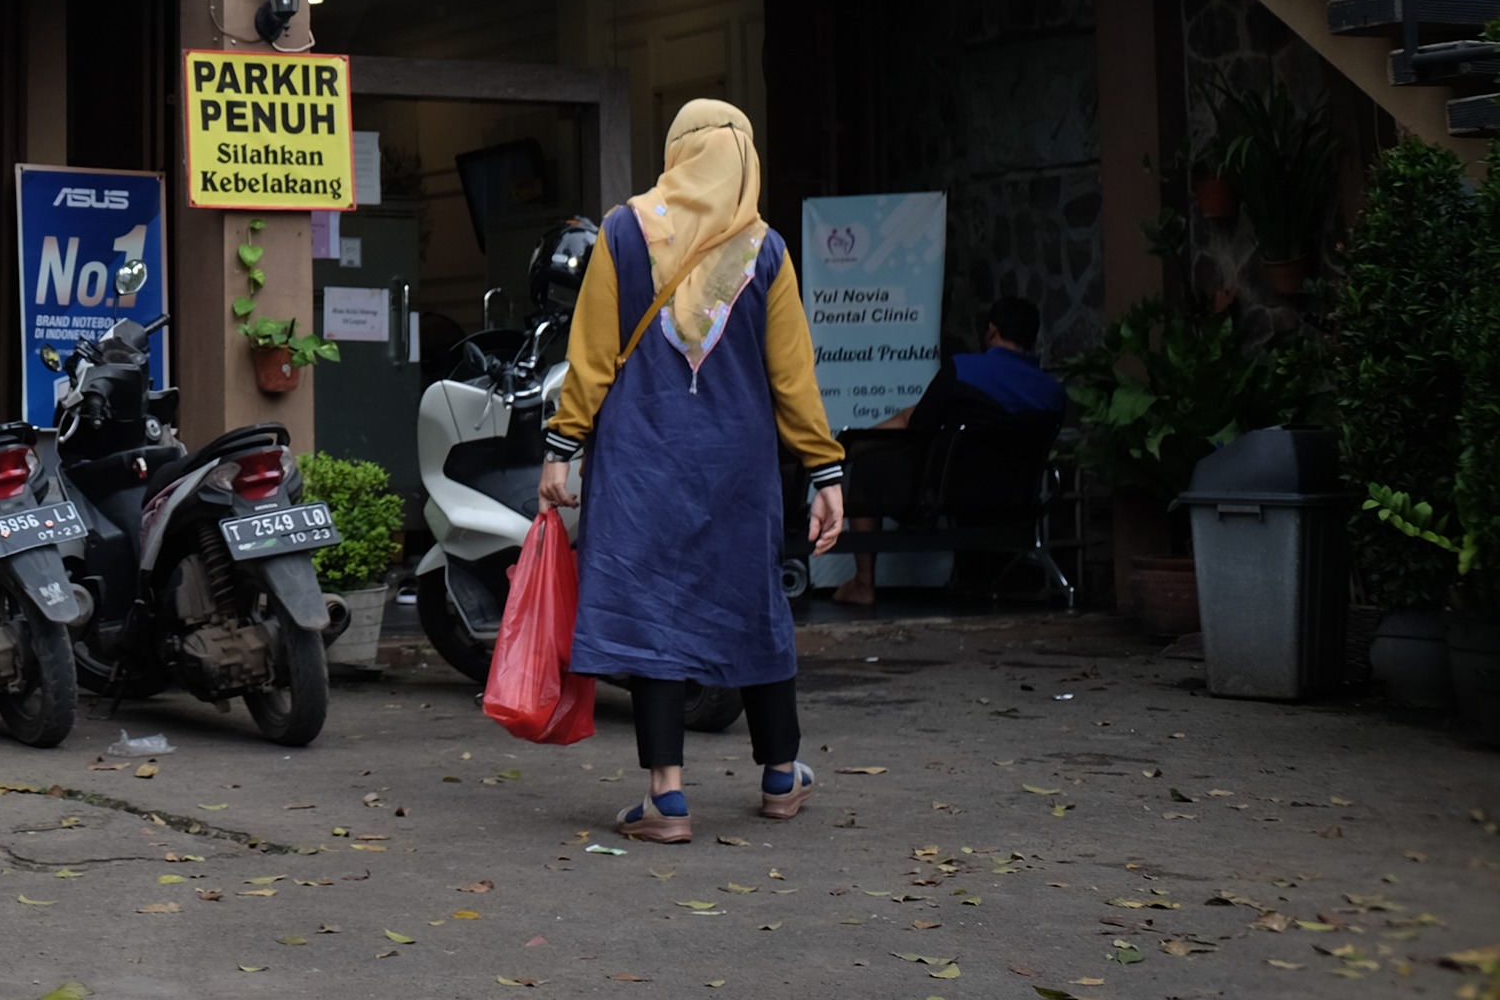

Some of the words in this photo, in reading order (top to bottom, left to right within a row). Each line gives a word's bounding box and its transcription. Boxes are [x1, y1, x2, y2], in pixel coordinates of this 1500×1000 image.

[193, 61, 339, 97] PARKIR
[200, 99, 336, 135] PENUH
[216, 142, 324, 166] Silahkan
[200, 170, 342, 200] Kebelakang
[53, 187, 130, 209] ASUS
[813, 289, 838, 304] Yul
[843, 287, 889, 303] Novia
[36, 315, 70, 328] BRAND
[813, 309, 867, 324] Dental
[871, 307, 919, 322] Clinic
[34, 328, 44, 339] DI
[45, 329, 96, 340] INDONESIA
[814, 345, 874, 366] Jadwal
[820, 387, 841, 396] am
[52, 505, 77, 523] LJ
[229, 525, 241, 541] T
[251, 513, 295, 537] 2549
